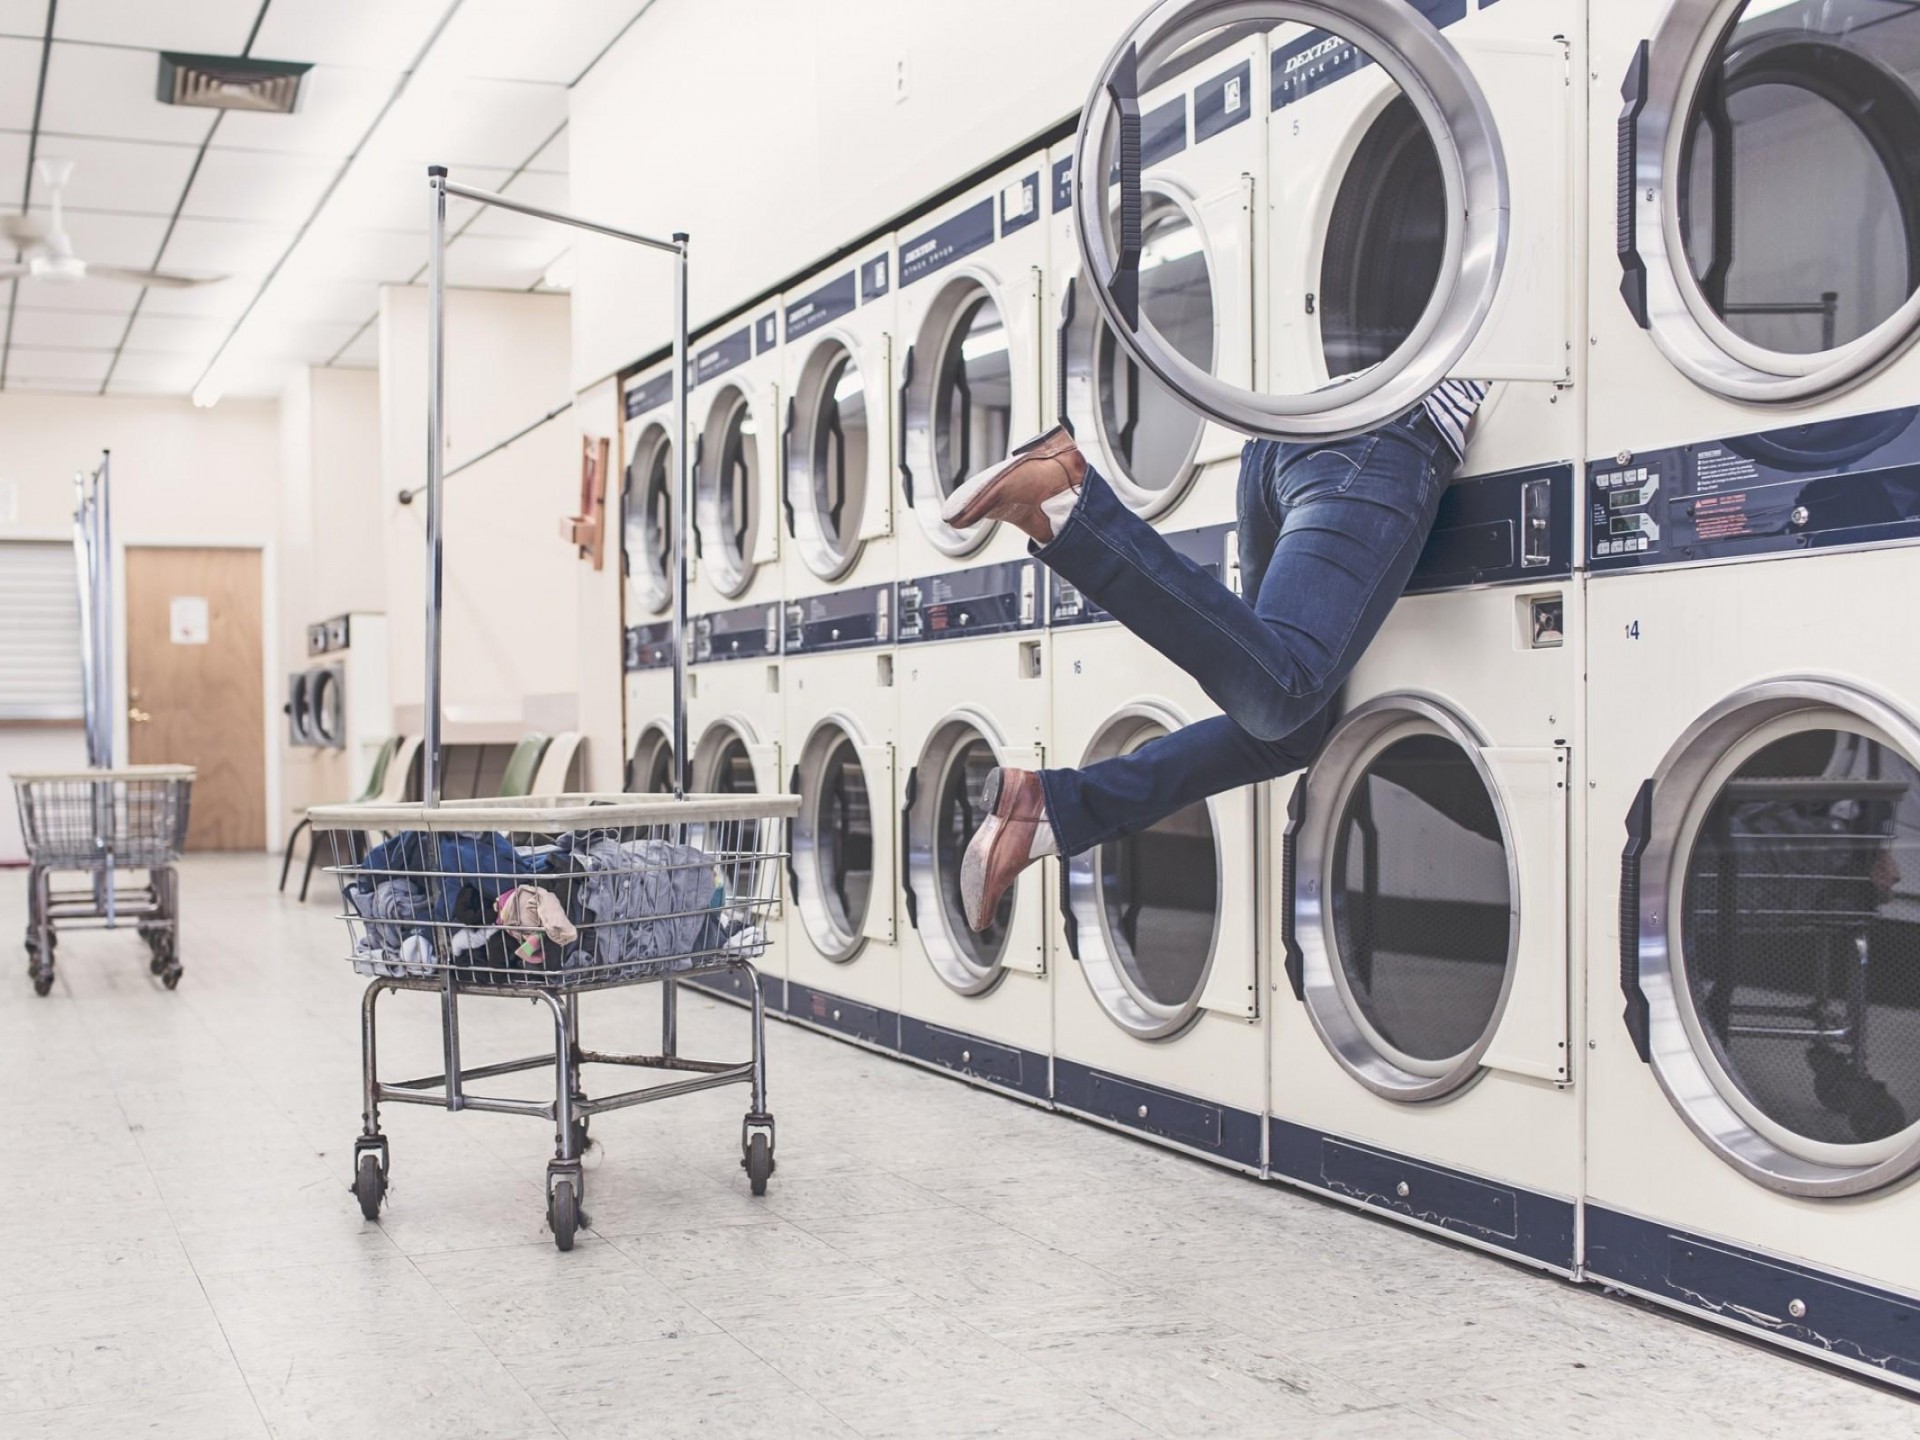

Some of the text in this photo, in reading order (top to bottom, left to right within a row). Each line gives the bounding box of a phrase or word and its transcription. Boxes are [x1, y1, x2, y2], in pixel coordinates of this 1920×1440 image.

[1284, 35, 1345, 74] DEXTER
[1284, 63, 1325, 91] STACK
[1293, 120, 1300, 136] 5
[1625, 620, 1640, 640] 14
[1074, 660, 1082, 675] 16
